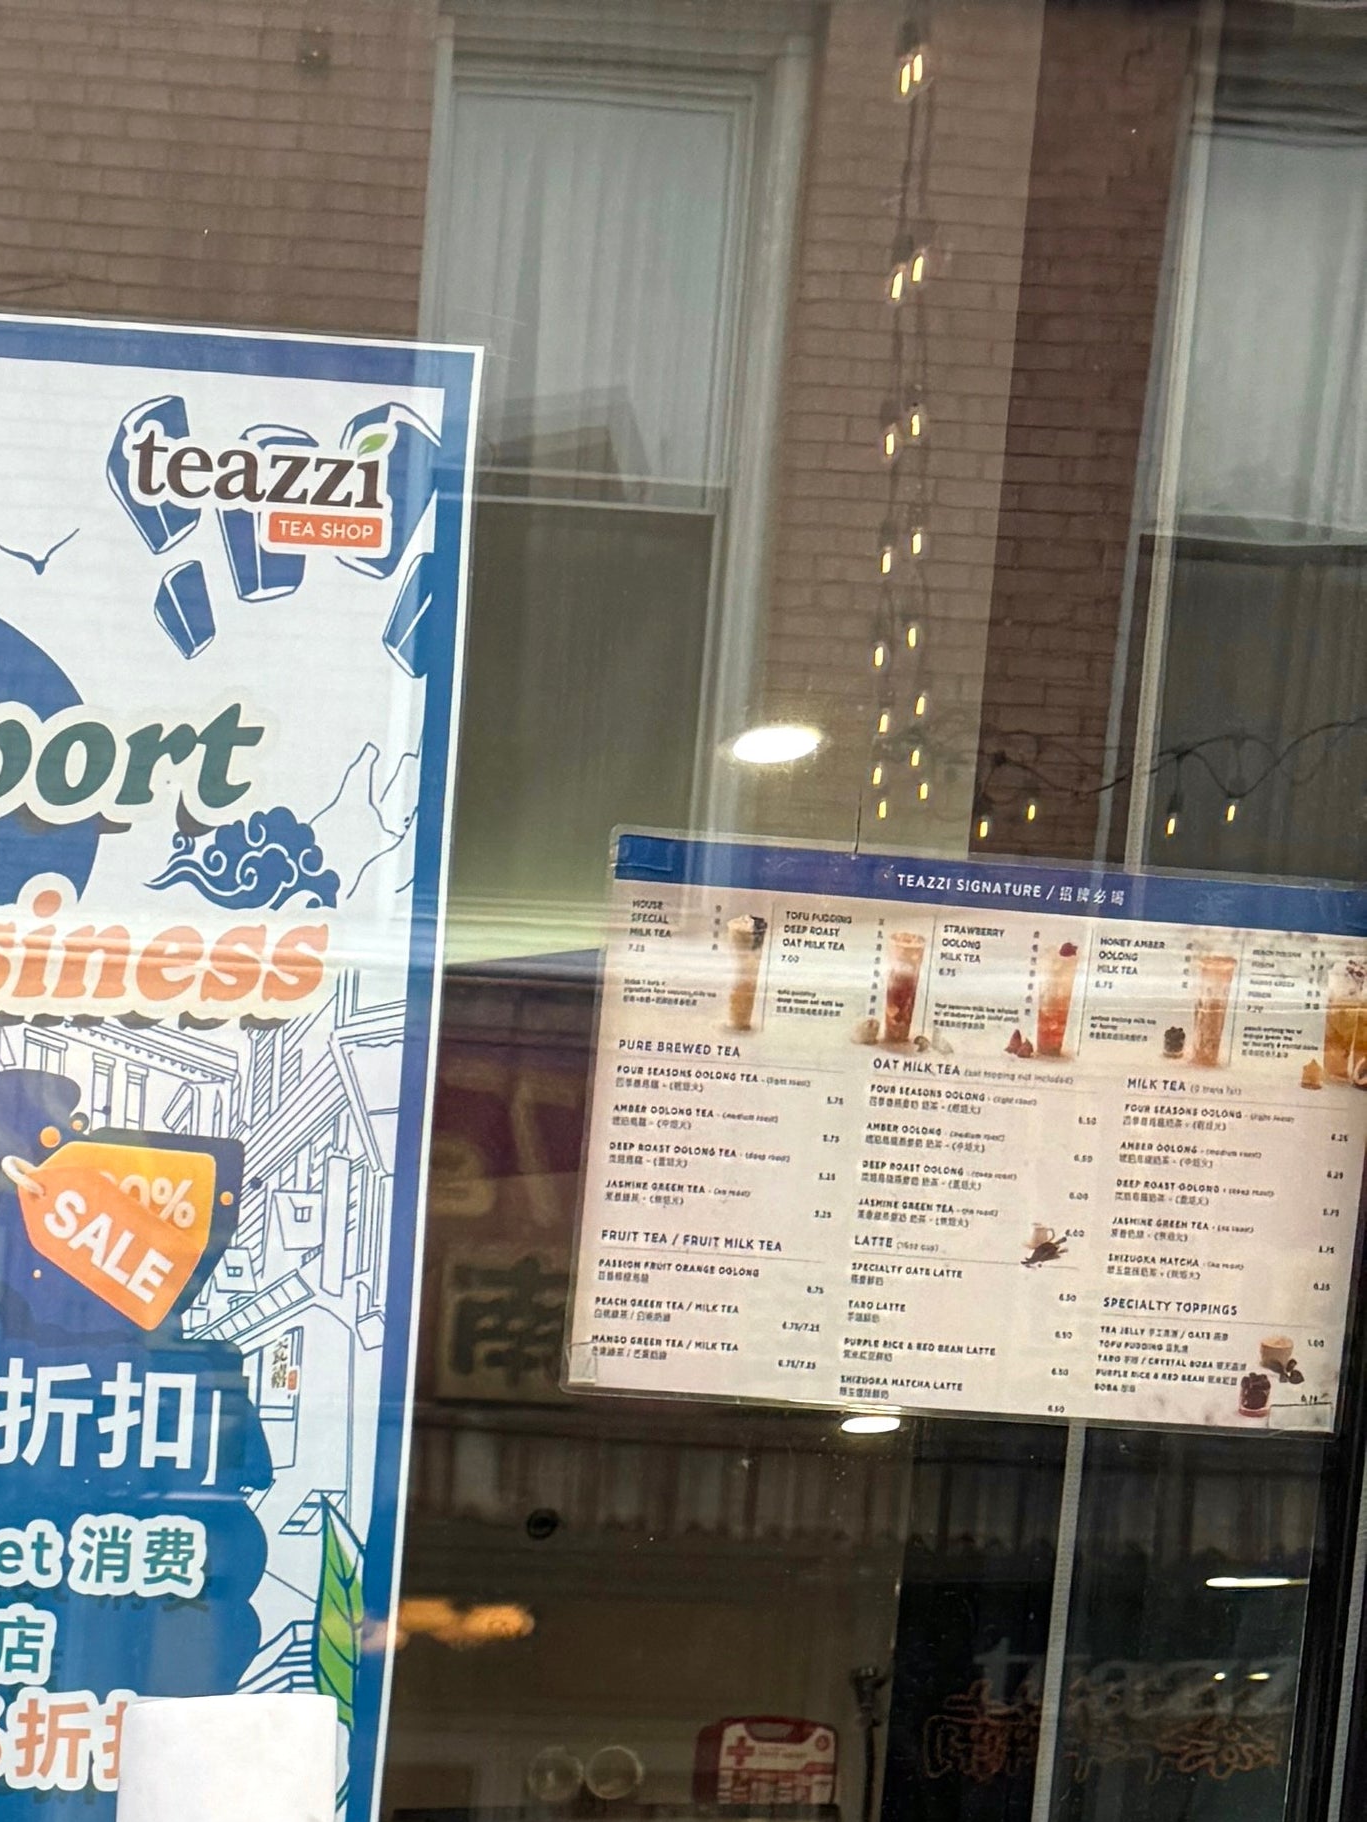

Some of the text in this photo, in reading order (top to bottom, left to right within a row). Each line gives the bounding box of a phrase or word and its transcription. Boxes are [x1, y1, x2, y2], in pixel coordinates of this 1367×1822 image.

[131, 430, 389, 509] teazzi
[279, 520, 373, 539] TEA SHOP
[897, 873, 951, 891] TEAZZI
[956, 878, 1042, 897] SIGNATURE
[619, 1039, 740, 1058] PURE BREWED TEA
[873, 1058, 961, 1076] OAT MILK TEA
[1127, 1078, 1186, 1092] MILK TEA
[44, 1189, 175, 1304] SALE
[601, 1230, 782, 1252] FRUIT TEA FRUIT MILK TEA
[854, 1235, 893, 1248] LATTE
[1103, 1297, 1238, 1316] SPECIALTY TOPPINGS
[78, 1525, 196, 1587] 消费
